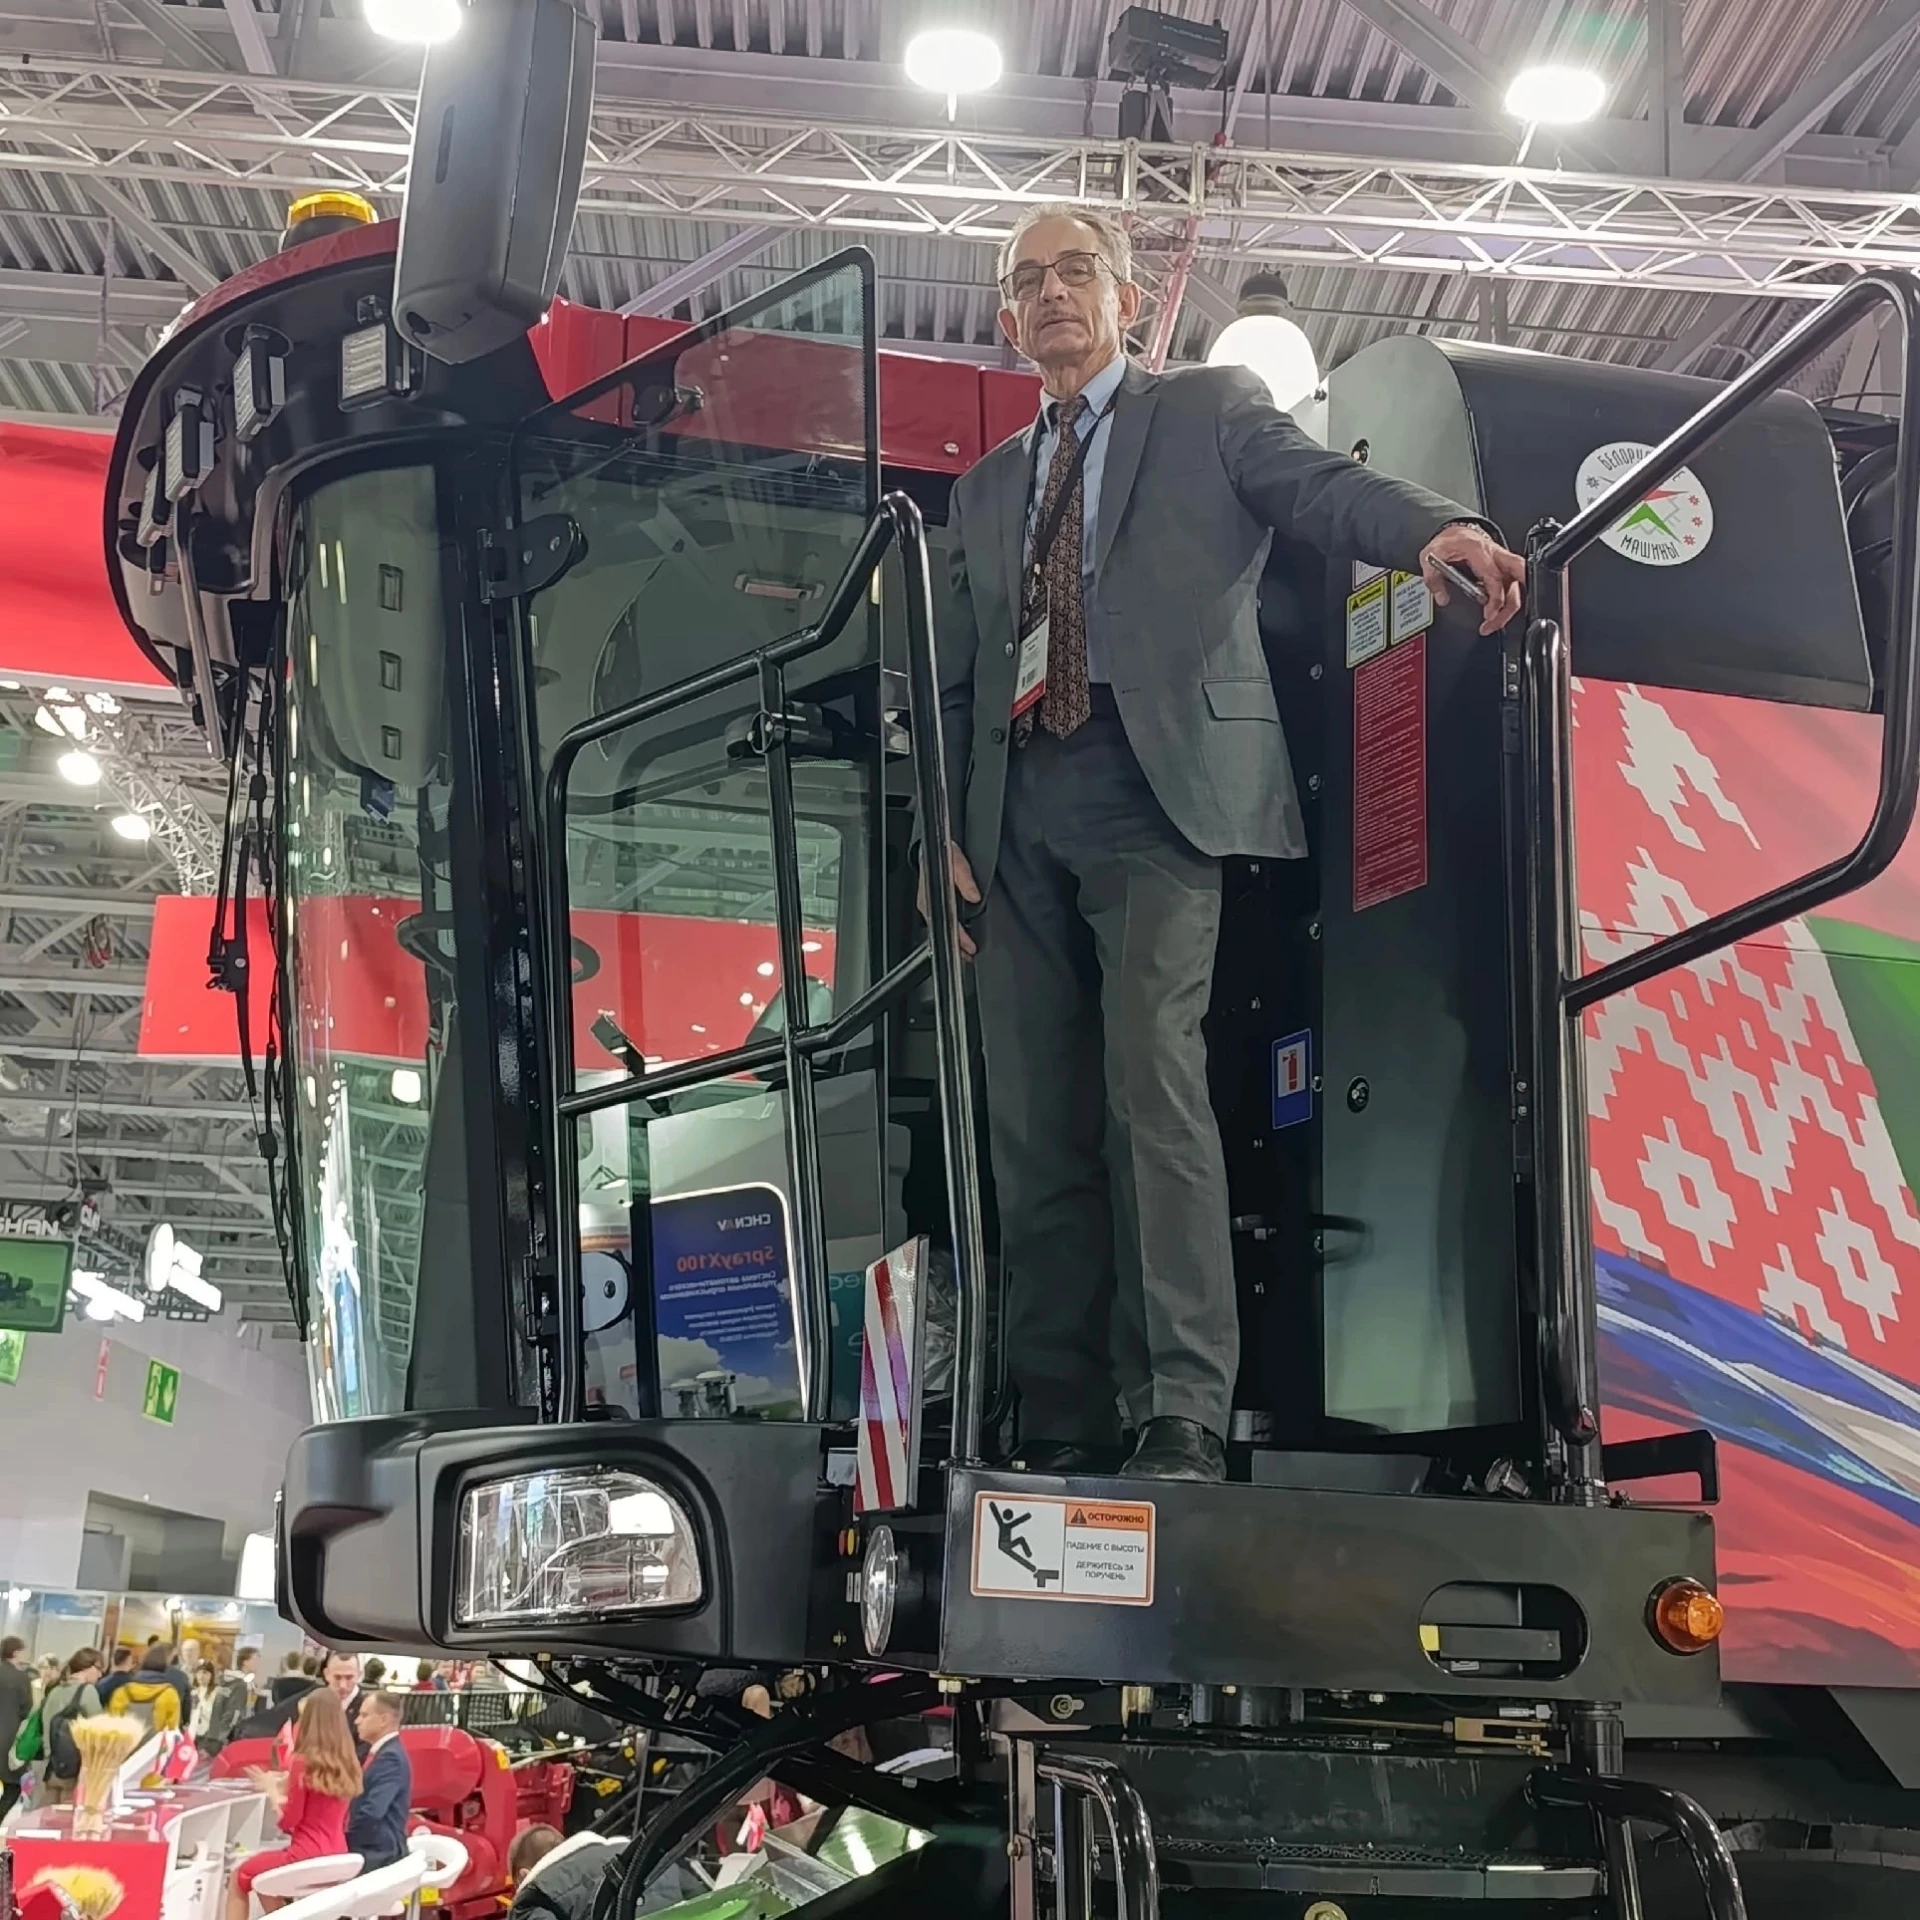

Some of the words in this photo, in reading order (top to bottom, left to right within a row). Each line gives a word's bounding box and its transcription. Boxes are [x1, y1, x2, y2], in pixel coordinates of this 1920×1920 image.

[1620, 534, 1680, 560] МАШИНЫ
[0, 1216, 60, 1236] HAN
[1087, 1512, 1144, 1524] ОСТОРОЖНО
[1066, 1541, 1102, 1551] ПАДЕНИЕ
[1103, 1543, 1110, 1551] С
[1111, 1544, 1145, 1553] ВЫСОТЫ
[1076, 1561, 1123, 1570] ДЕРЖИТЕСЬ
[1124, 1563, 1134, 1571] ЗА
[1085, 1571, 1126, 1581] ПОРУЧЕНЬ
